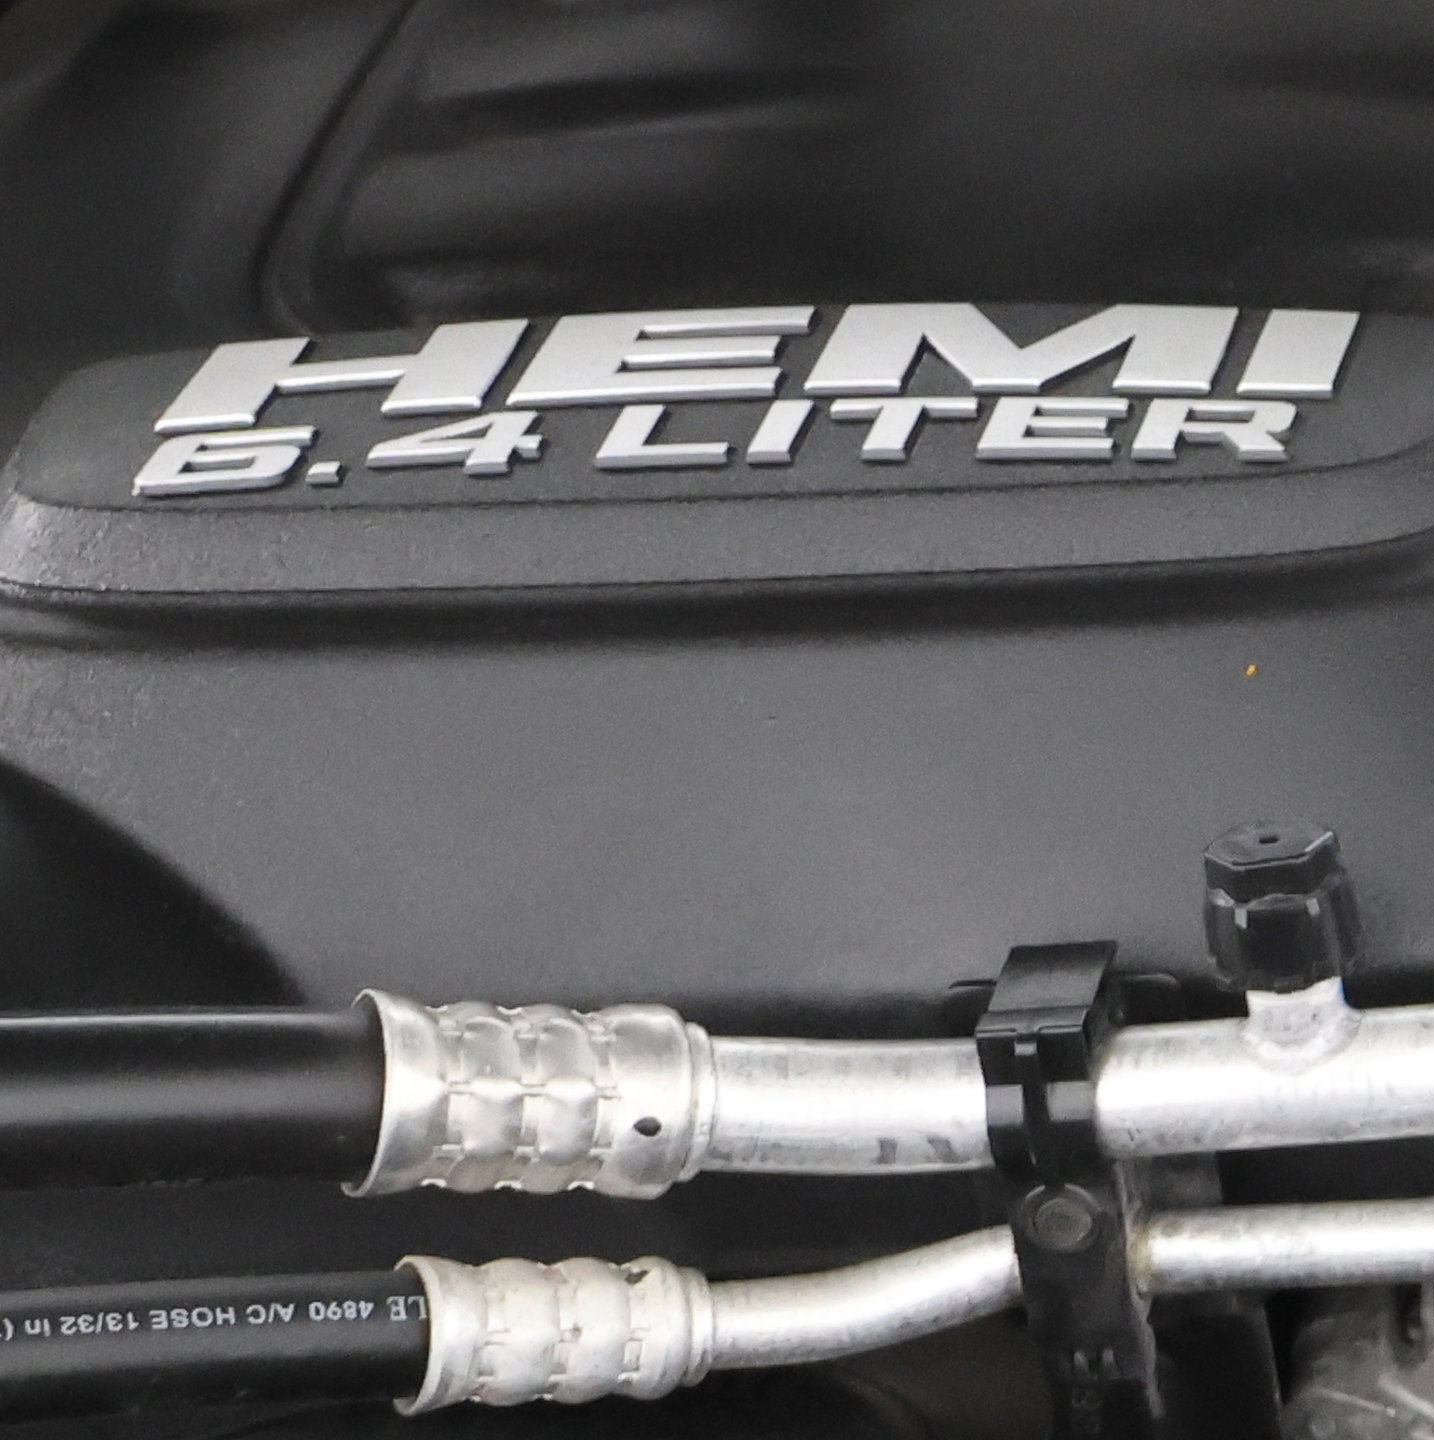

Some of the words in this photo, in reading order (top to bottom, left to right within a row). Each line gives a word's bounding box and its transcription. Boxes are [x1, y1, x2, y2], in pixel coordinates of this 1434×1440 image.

[153, 301, 1361, 435] HEMI
[131, 410, 543, 498] 6.4
[593, 395, 1305, 468] LITER
[150, 1307, 236, 1331] HOSE
[246, 1303, 295, 1325] A/C
[308, 1301, 375, 1321] 4890
[60, 1312, 140, 1336] 13/32
